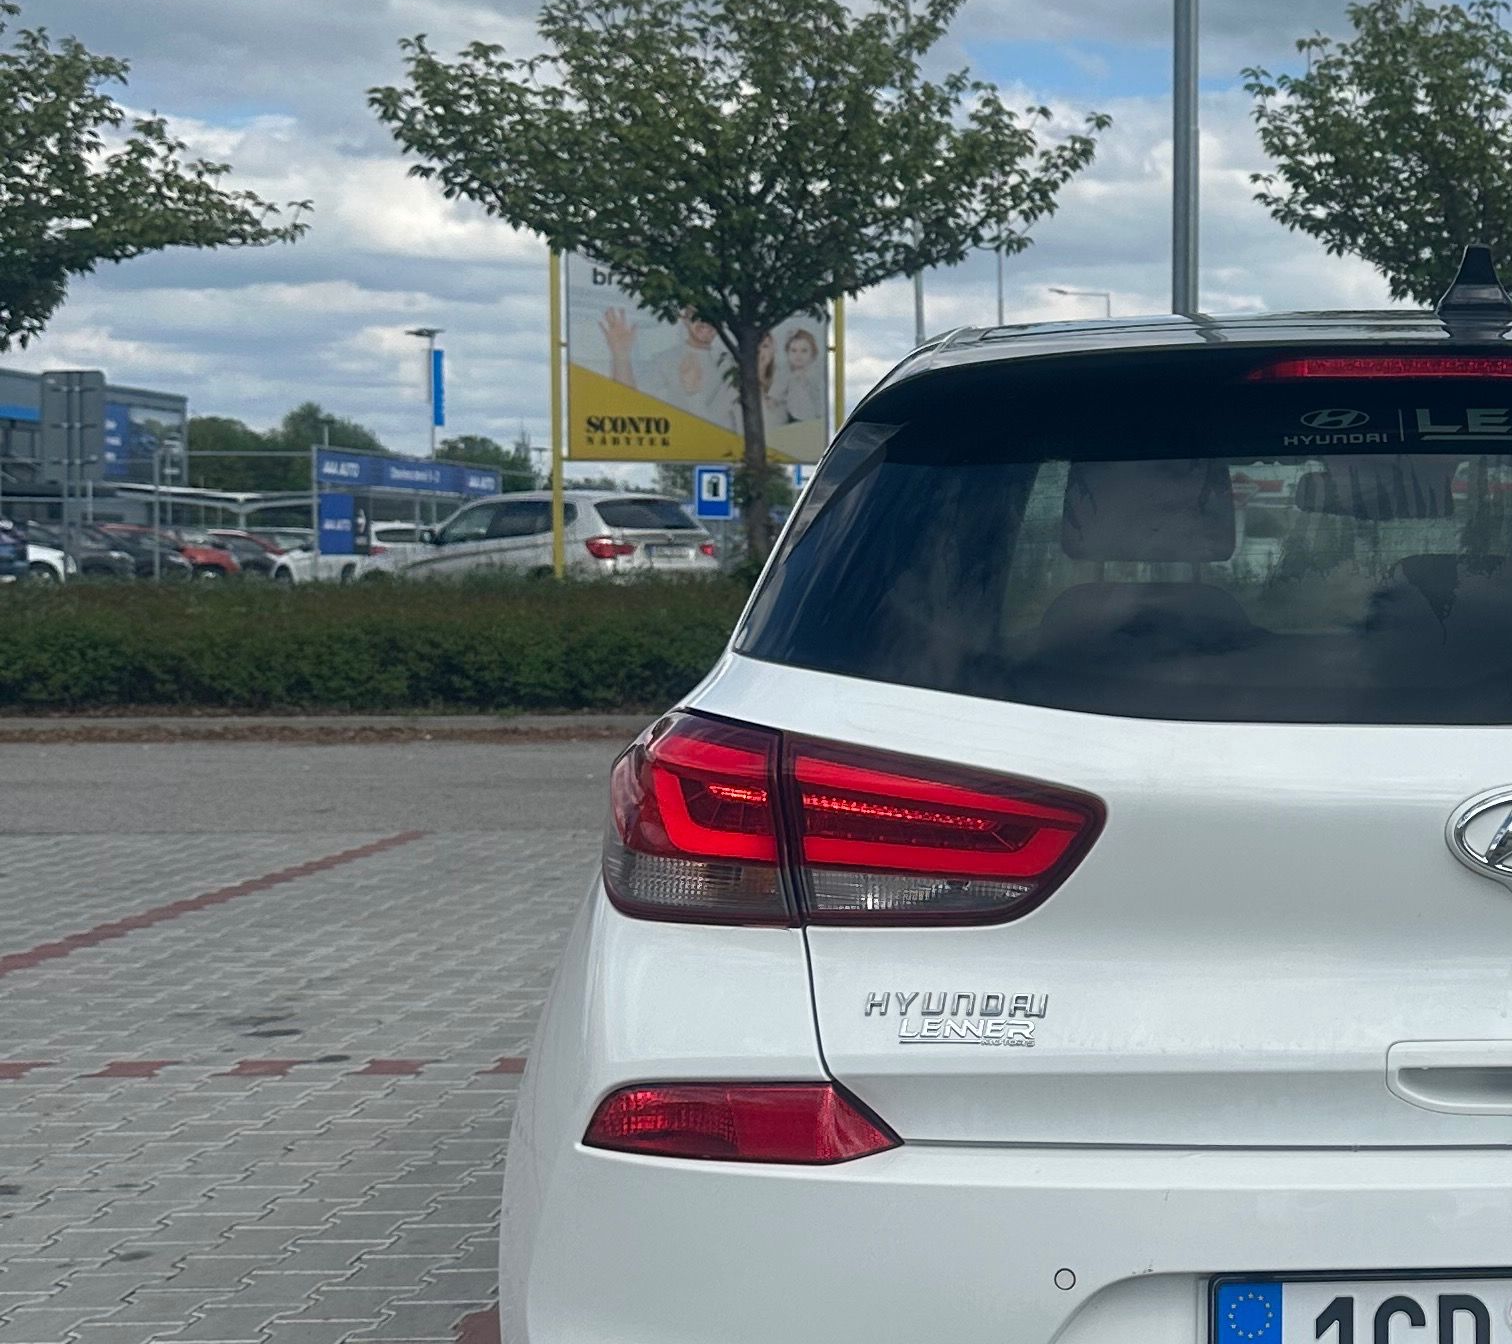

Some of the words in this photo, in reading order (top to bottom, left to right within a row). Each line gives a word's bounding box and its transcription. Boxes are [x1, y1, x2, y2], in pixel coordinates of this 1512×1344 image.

[586, 416, 670, 435] SCONTO
[1283, 432, 1387, 446] HYUNDAI
[865, 992, 1048, 1018] HYUNDAI
[898, 1017, 1036, 1040] LENNER
